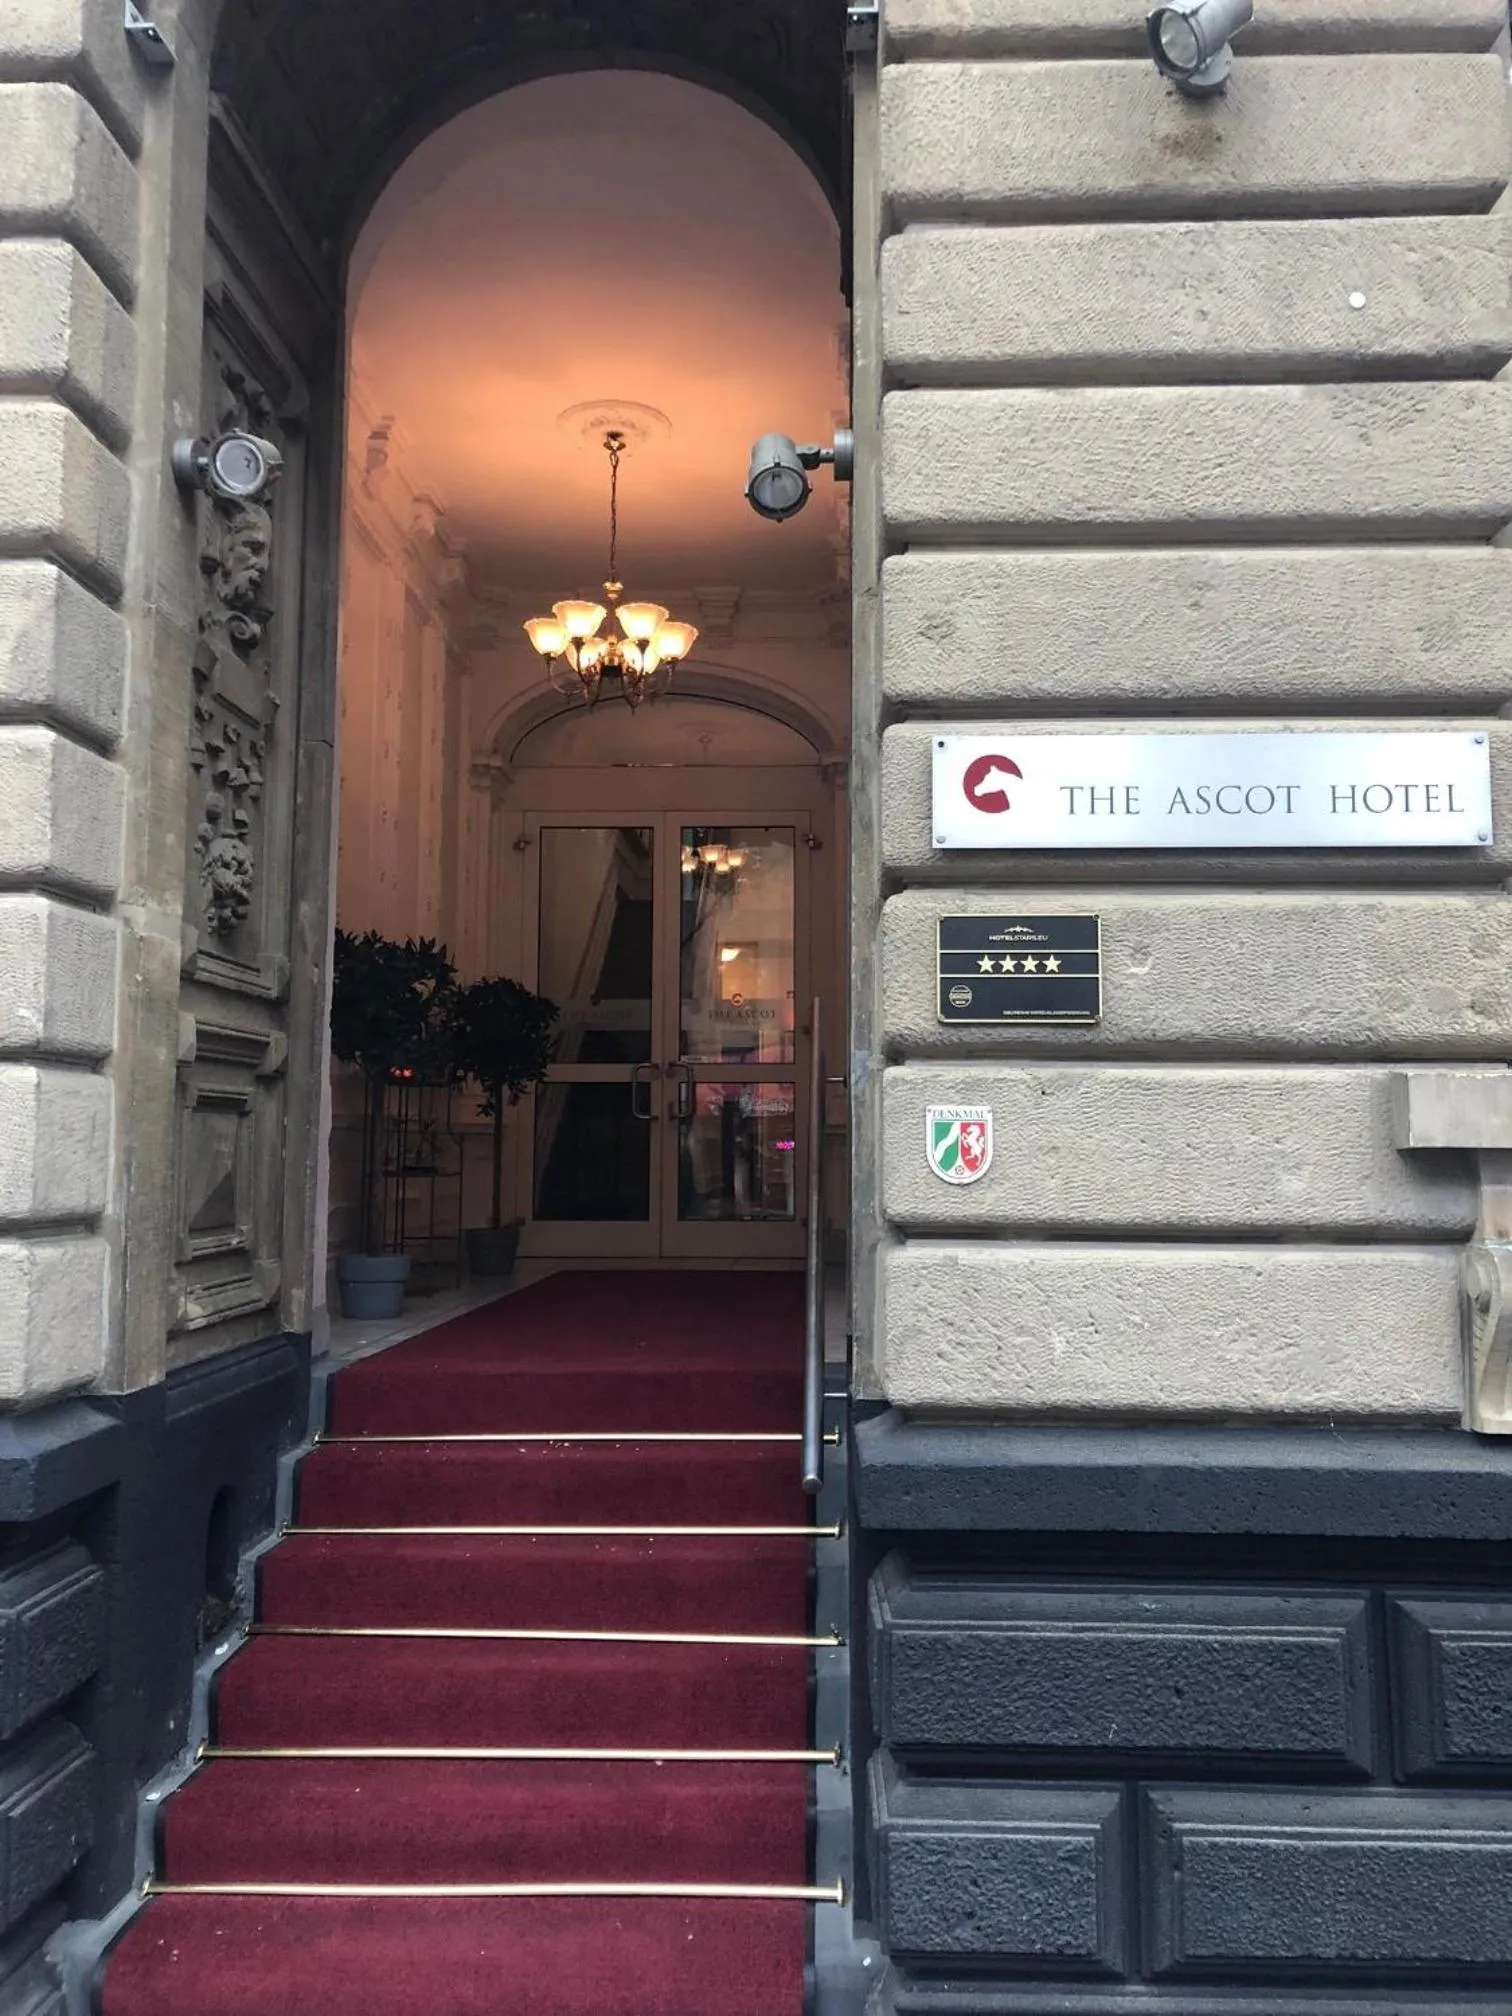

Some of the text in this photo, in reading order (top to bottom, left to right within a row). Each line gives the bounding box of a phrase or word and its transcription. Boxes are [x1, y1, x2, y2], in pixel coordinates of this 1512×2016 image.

[1059, 783, 1465, 816] THE ASCOT HOTEL
[932, 1108, 985, 1119] DENKMAL
